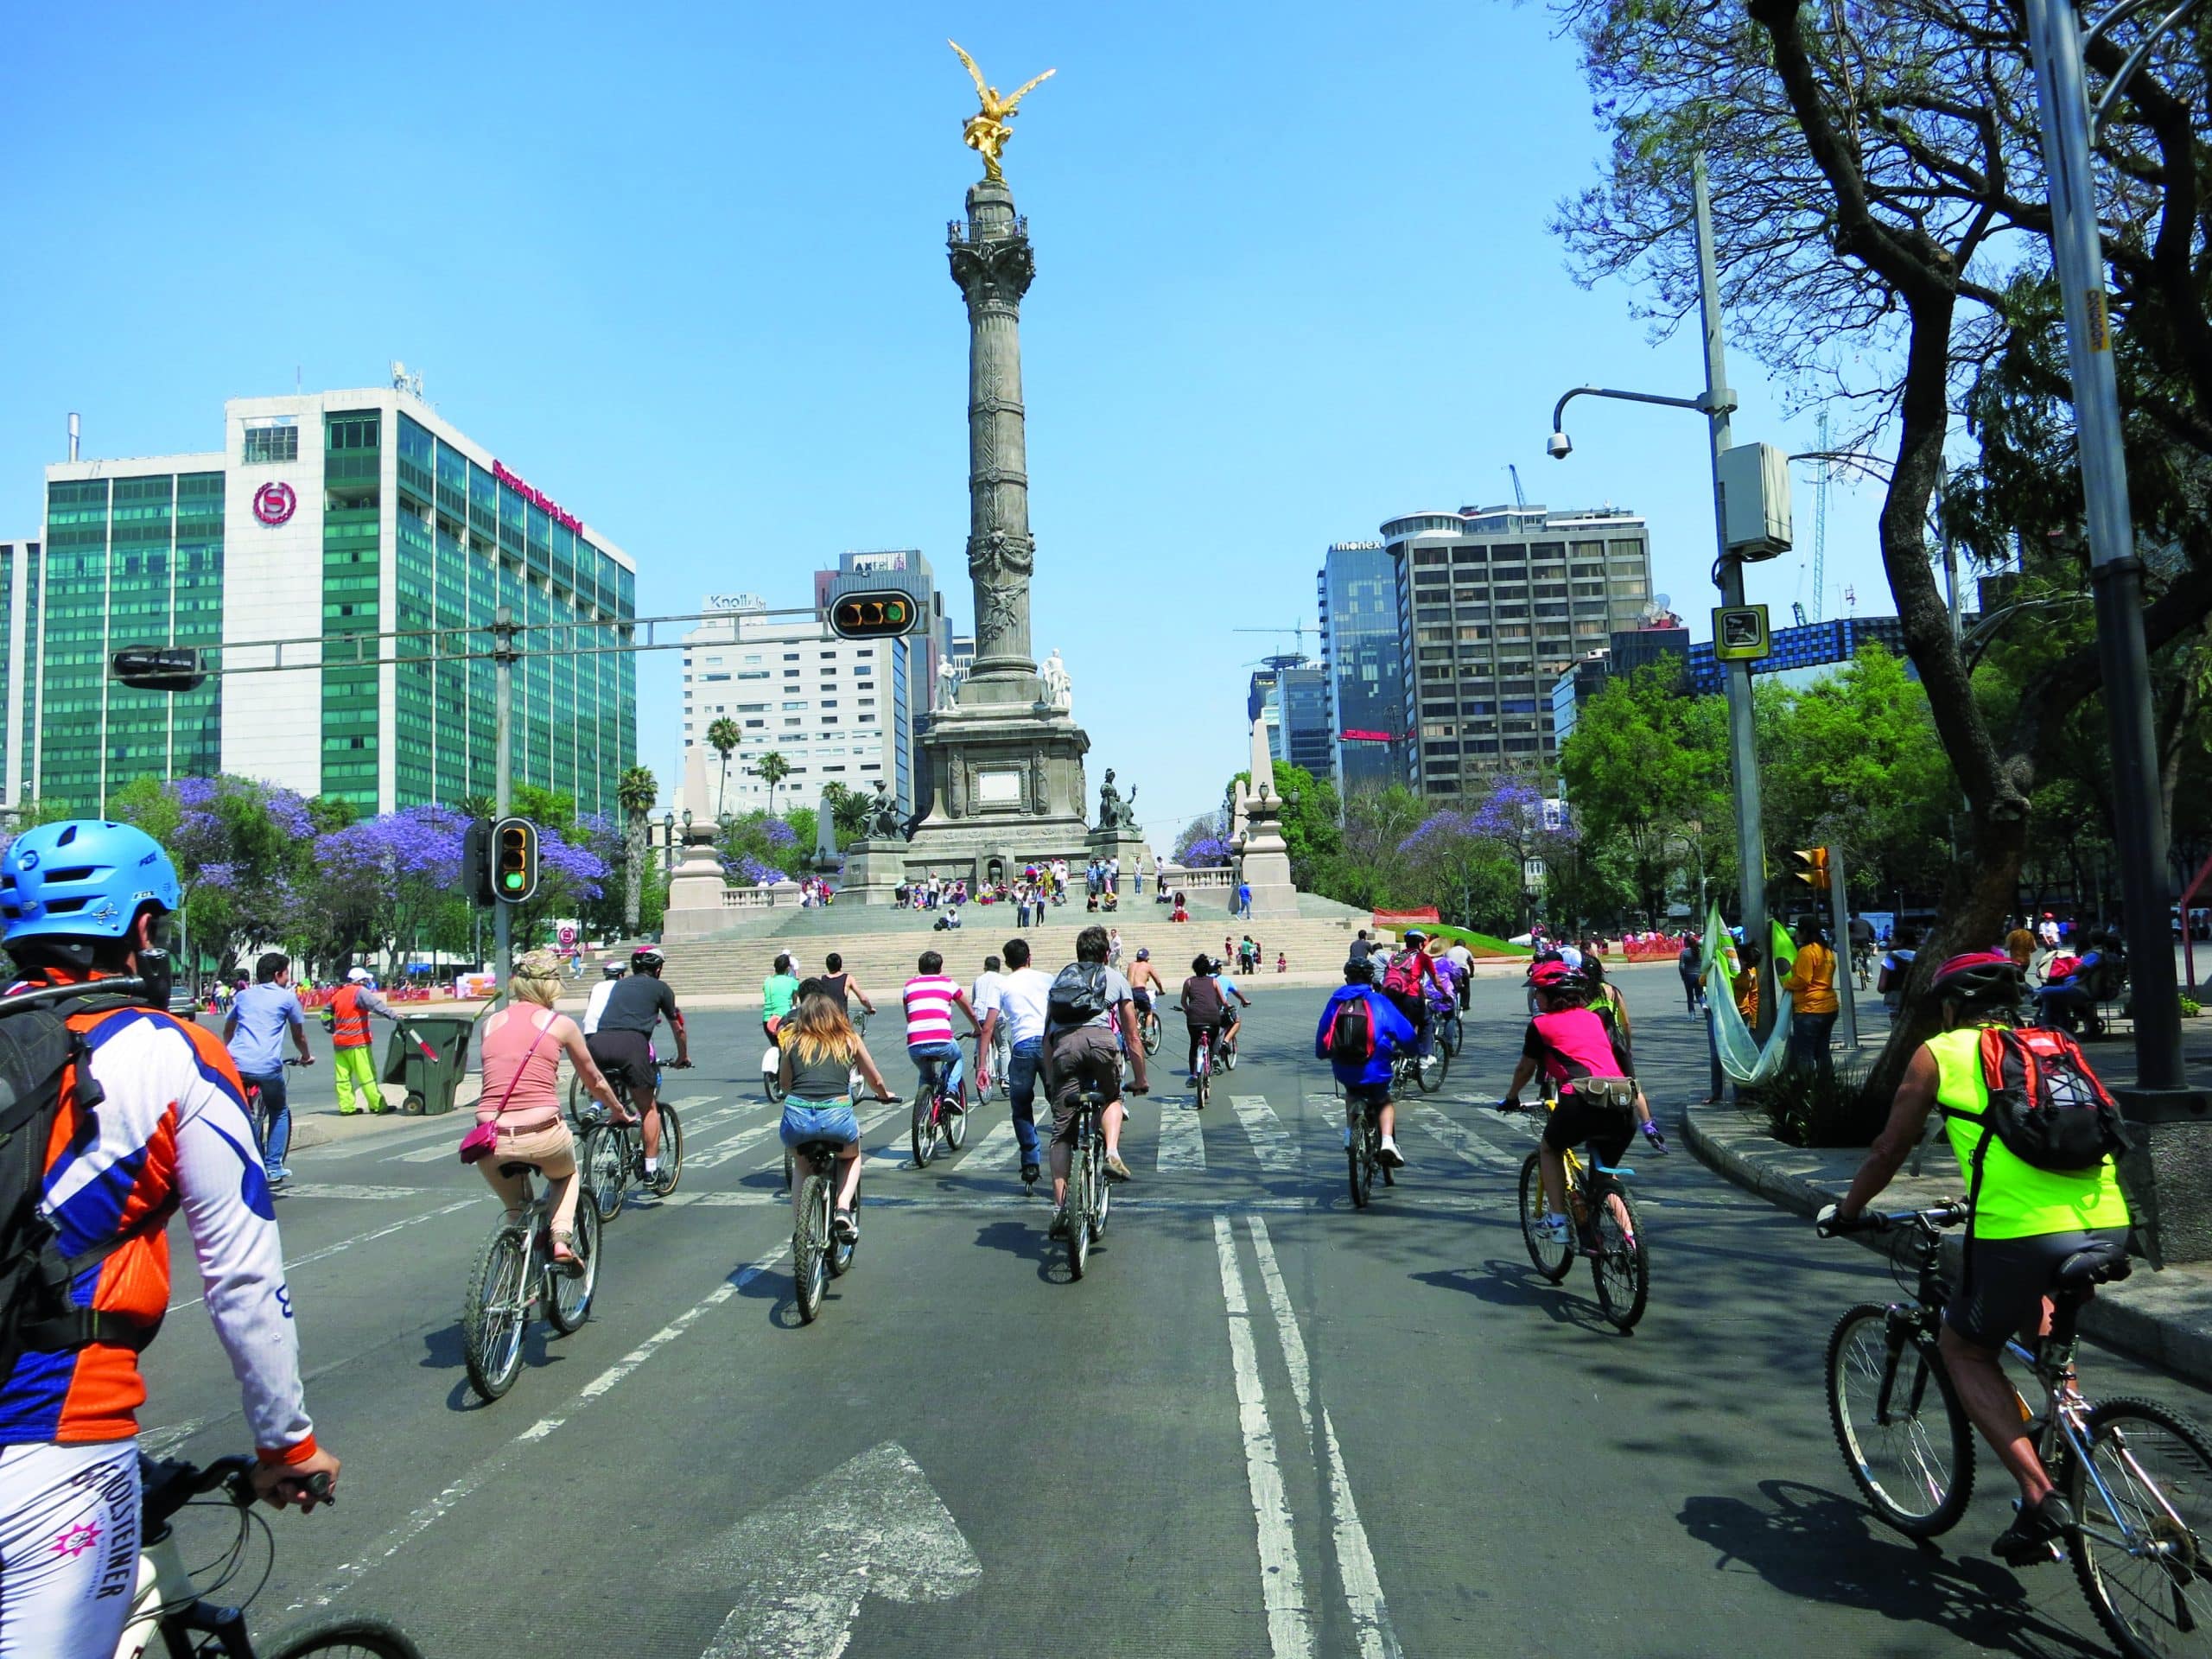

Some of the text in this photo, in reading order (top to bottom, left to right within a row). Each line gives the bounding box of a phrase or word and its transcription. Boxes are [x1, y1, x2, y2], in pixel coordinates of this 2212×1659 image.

[493, 459, 535, 503] Sheraton
[264, 488, 285, 513] S
[1337, 540, 1381, 551] monex
[710, 594, 747, 608] Knoll
[133, 890, 156, 900] FOX
